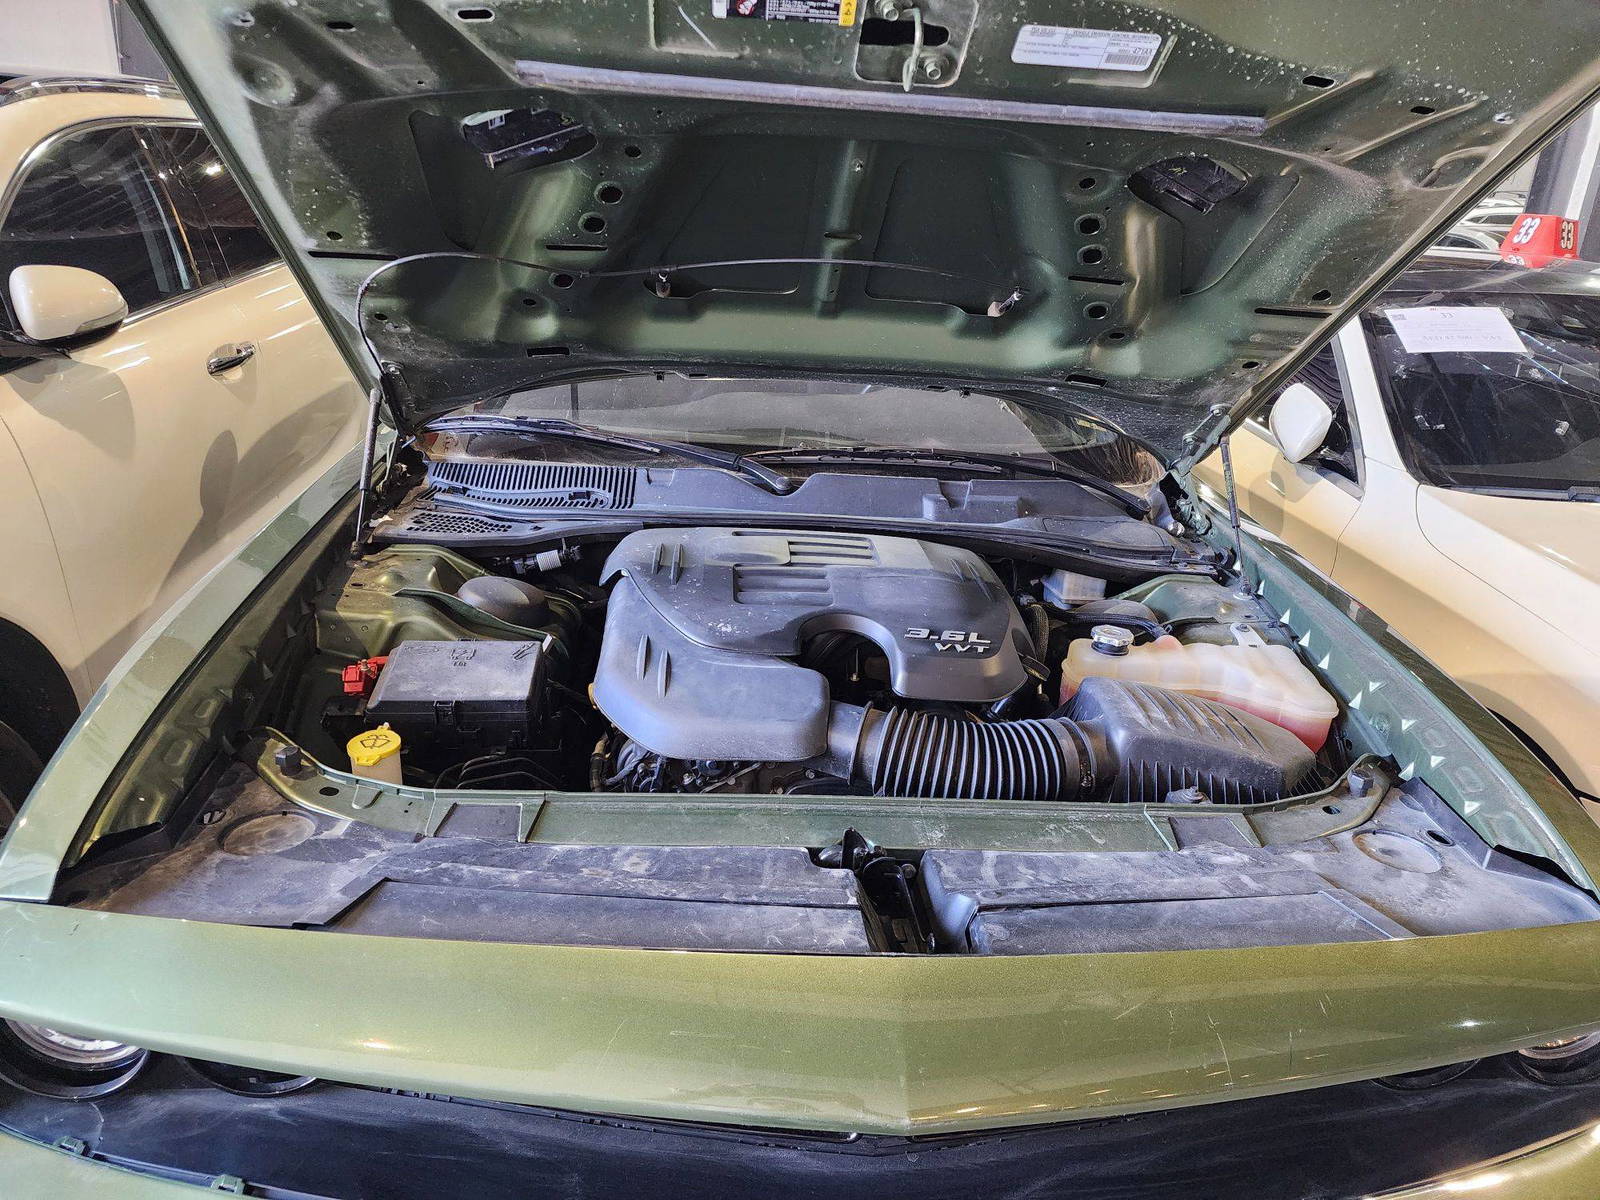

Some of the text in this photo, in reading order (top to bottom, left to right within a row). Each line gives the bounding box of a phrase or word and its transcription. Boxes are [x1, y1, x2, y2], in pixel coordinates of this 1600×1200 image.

[1512, 217, 1541, 245] 33
[1561, 220, 1575, 250] 33
[904, 627, 992, 644] 3.6L
[934, 642, 990, 654] VVT
